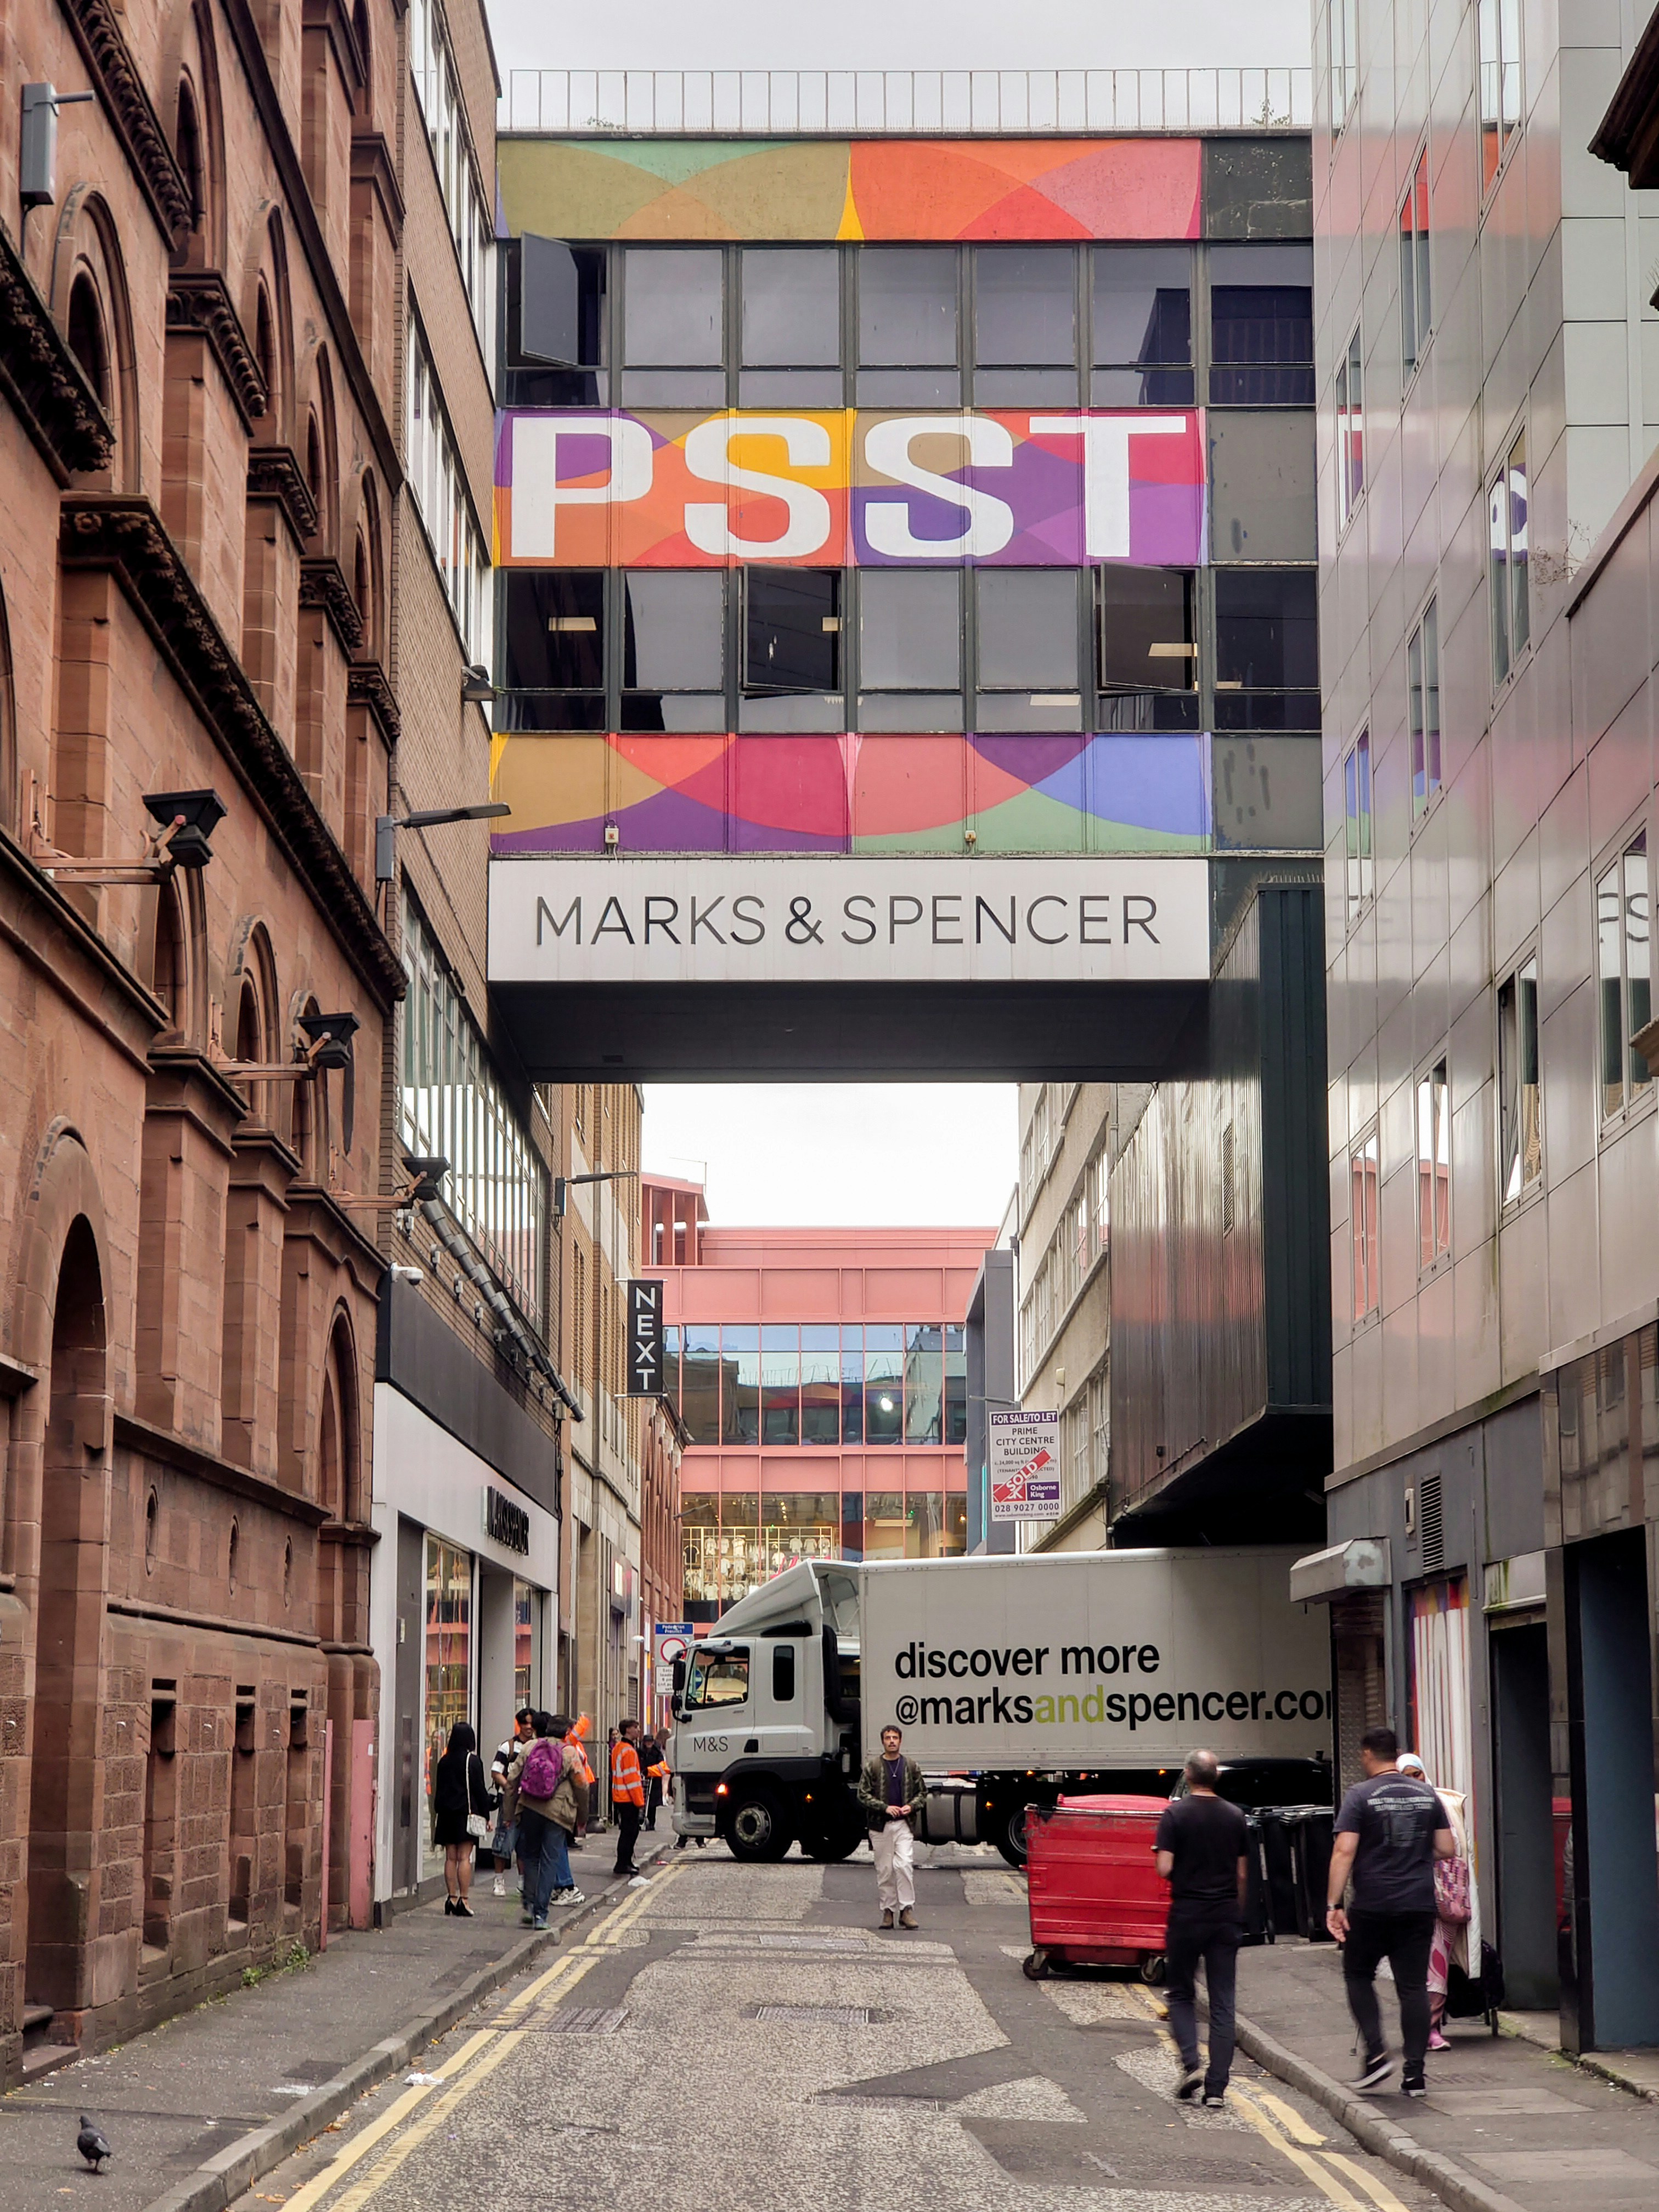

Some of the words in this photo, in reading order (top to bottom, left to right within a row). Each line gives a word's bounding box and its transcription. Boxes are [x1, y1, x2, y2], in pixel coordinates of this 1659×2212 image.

[510, 415, 1186, 558] PSST
[536, 895, 766, 946] MARKS
[785, 896, 824, 945] &
[841, 895, 1161, 945] SPENCER
[635, 1286, 656, 1391] NEXT
[992, 1415, 1009, 1424] FOR
[1042, 1412, 1057, 1421] LET
[1012, 1427, 1038, 1435] PRIME
[1019, 1436, 1055, 1444] CENTRE
[1006, 1461, 1038, 1492] SOLD
[895, 1641, 1049, 1679] discover
[1061, 1644, 1160, 1675] more
[895, 1684, 1331, 1731] @marksandspencer.co
[693, 1736, 729, 1752] M&S
